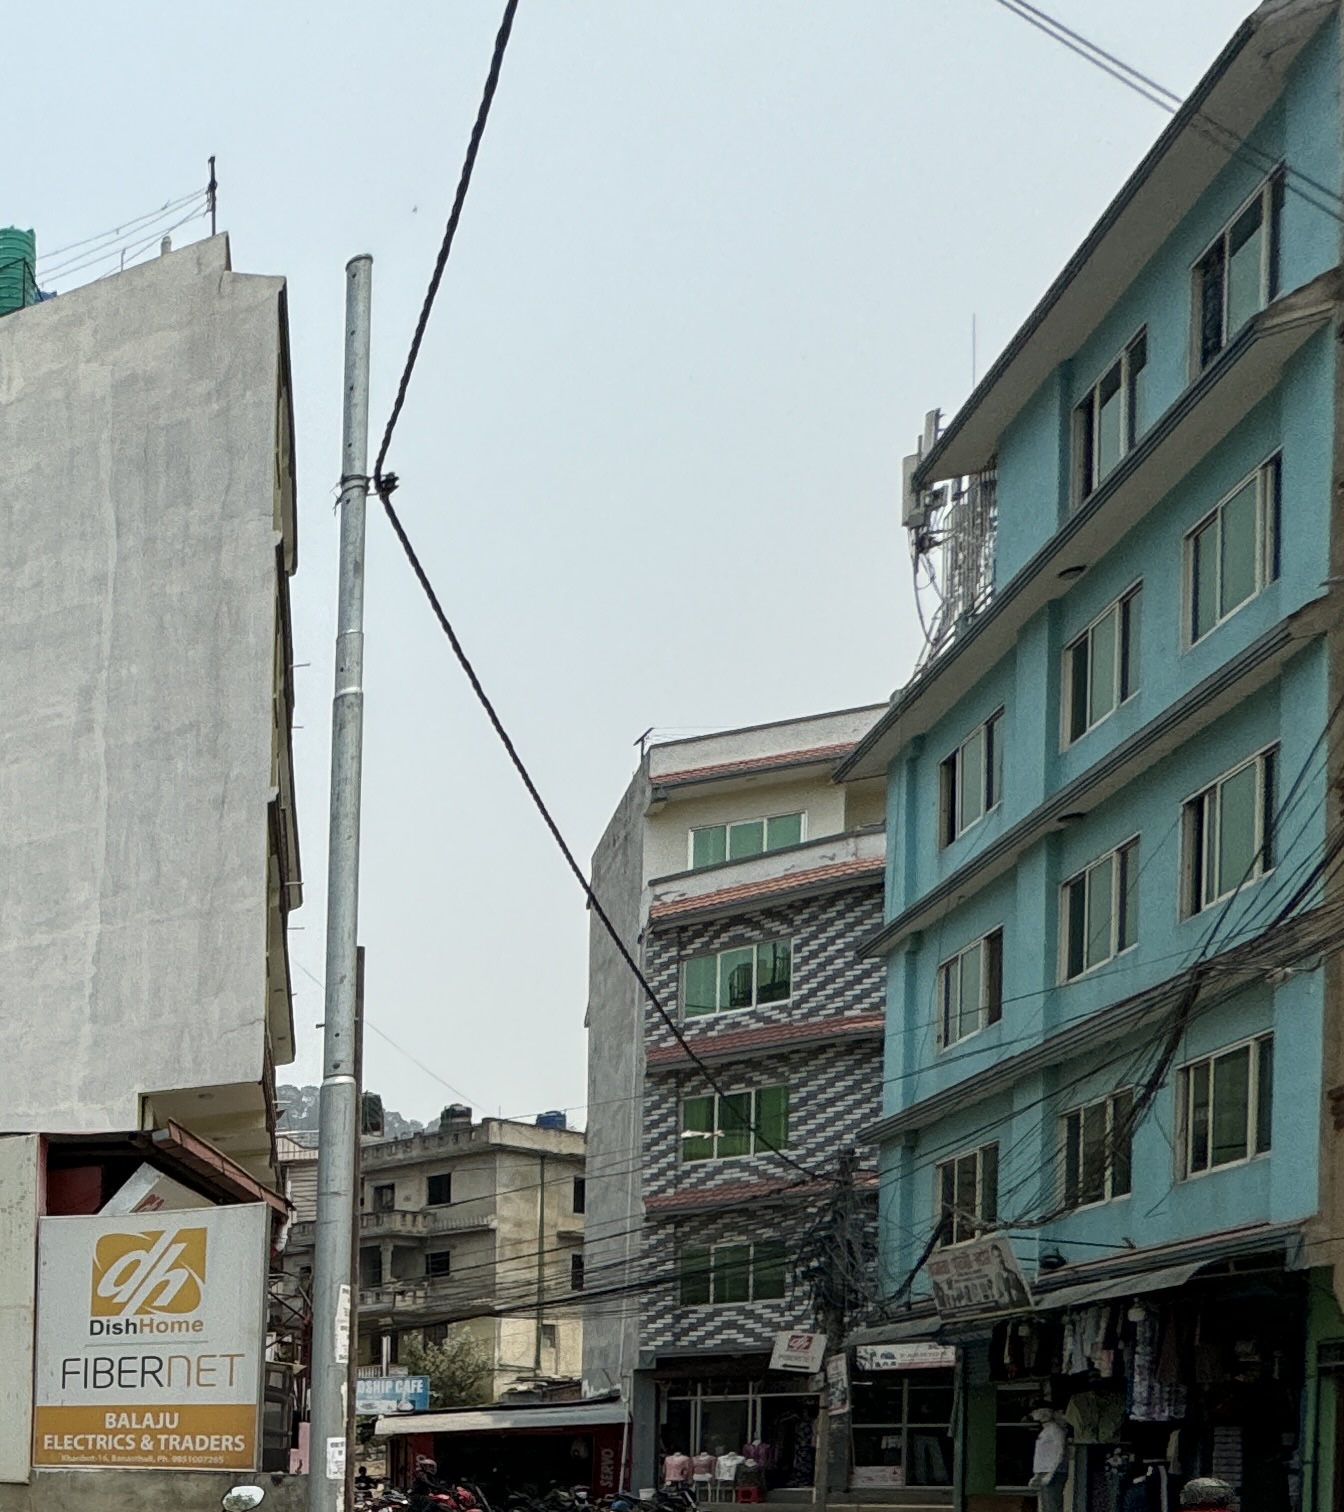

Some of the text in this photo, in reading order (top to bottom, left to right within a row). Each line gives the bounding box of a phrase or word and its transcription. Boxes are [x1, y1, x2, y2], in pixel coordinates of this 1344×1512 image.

[89, 1317, 204, 1336] DishHome
[61, 1353, 245, 1389] FIBERNET
[395, 1379, 423, 1393] CAFE
[104, 1412, 180, 1429] BALAJU
[43, 1434, 246, 1452] ELECTRICS & TRADERS
[600, 1448, 614, 1488] SERVO
